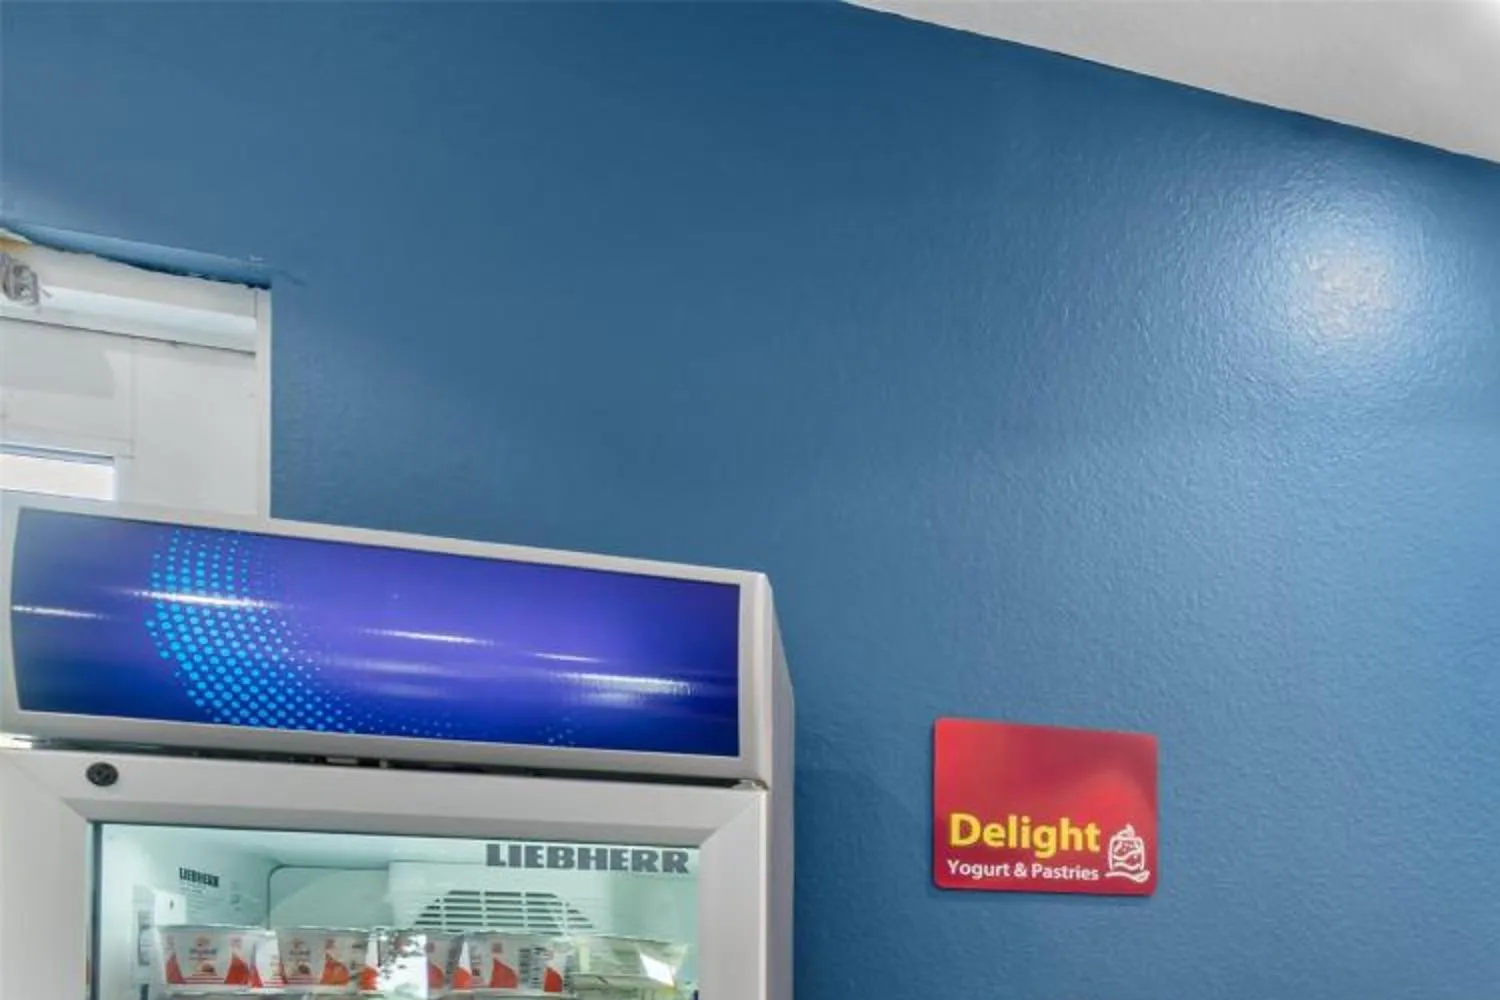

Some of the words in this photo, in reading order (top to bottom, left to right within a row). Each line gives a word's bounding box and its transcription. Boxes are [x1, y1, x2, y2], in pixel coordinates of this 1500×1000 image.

[950, 813, 1101, 859] Delight
[486, 844, 689, 874] LIEBHERR
[947, 859, 1010, 880] Yogurt
[1014, 862, 1027, 877] &
[1031, 864, 1099, 880] Pastries
